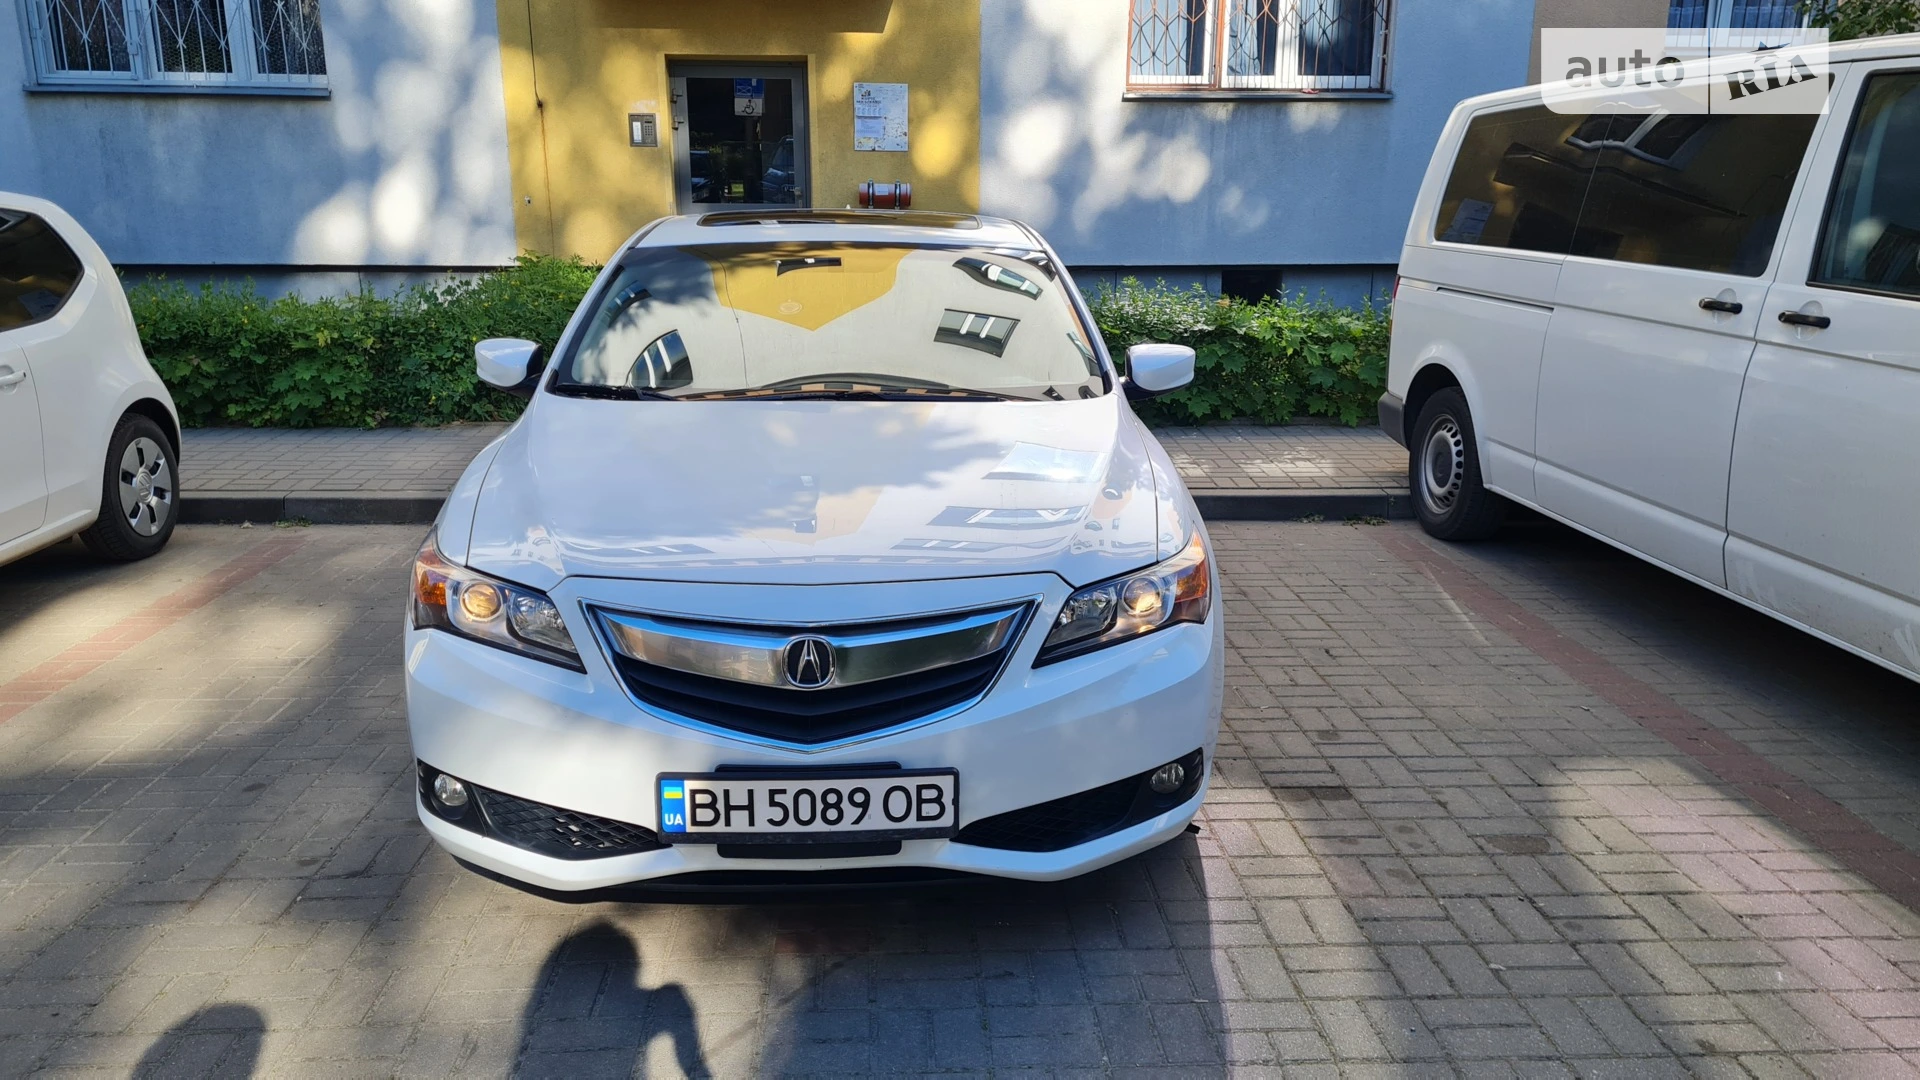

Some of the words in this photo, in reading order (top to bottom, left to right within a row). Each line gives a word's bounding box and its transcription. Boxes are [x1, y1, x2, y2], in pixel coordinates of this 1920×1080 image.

[689, 788, 755, 827] BH
[766, 787, 871, 826] 5089
[882, 783, 946, 823] OB
[664, 813, 683, 826] UA
